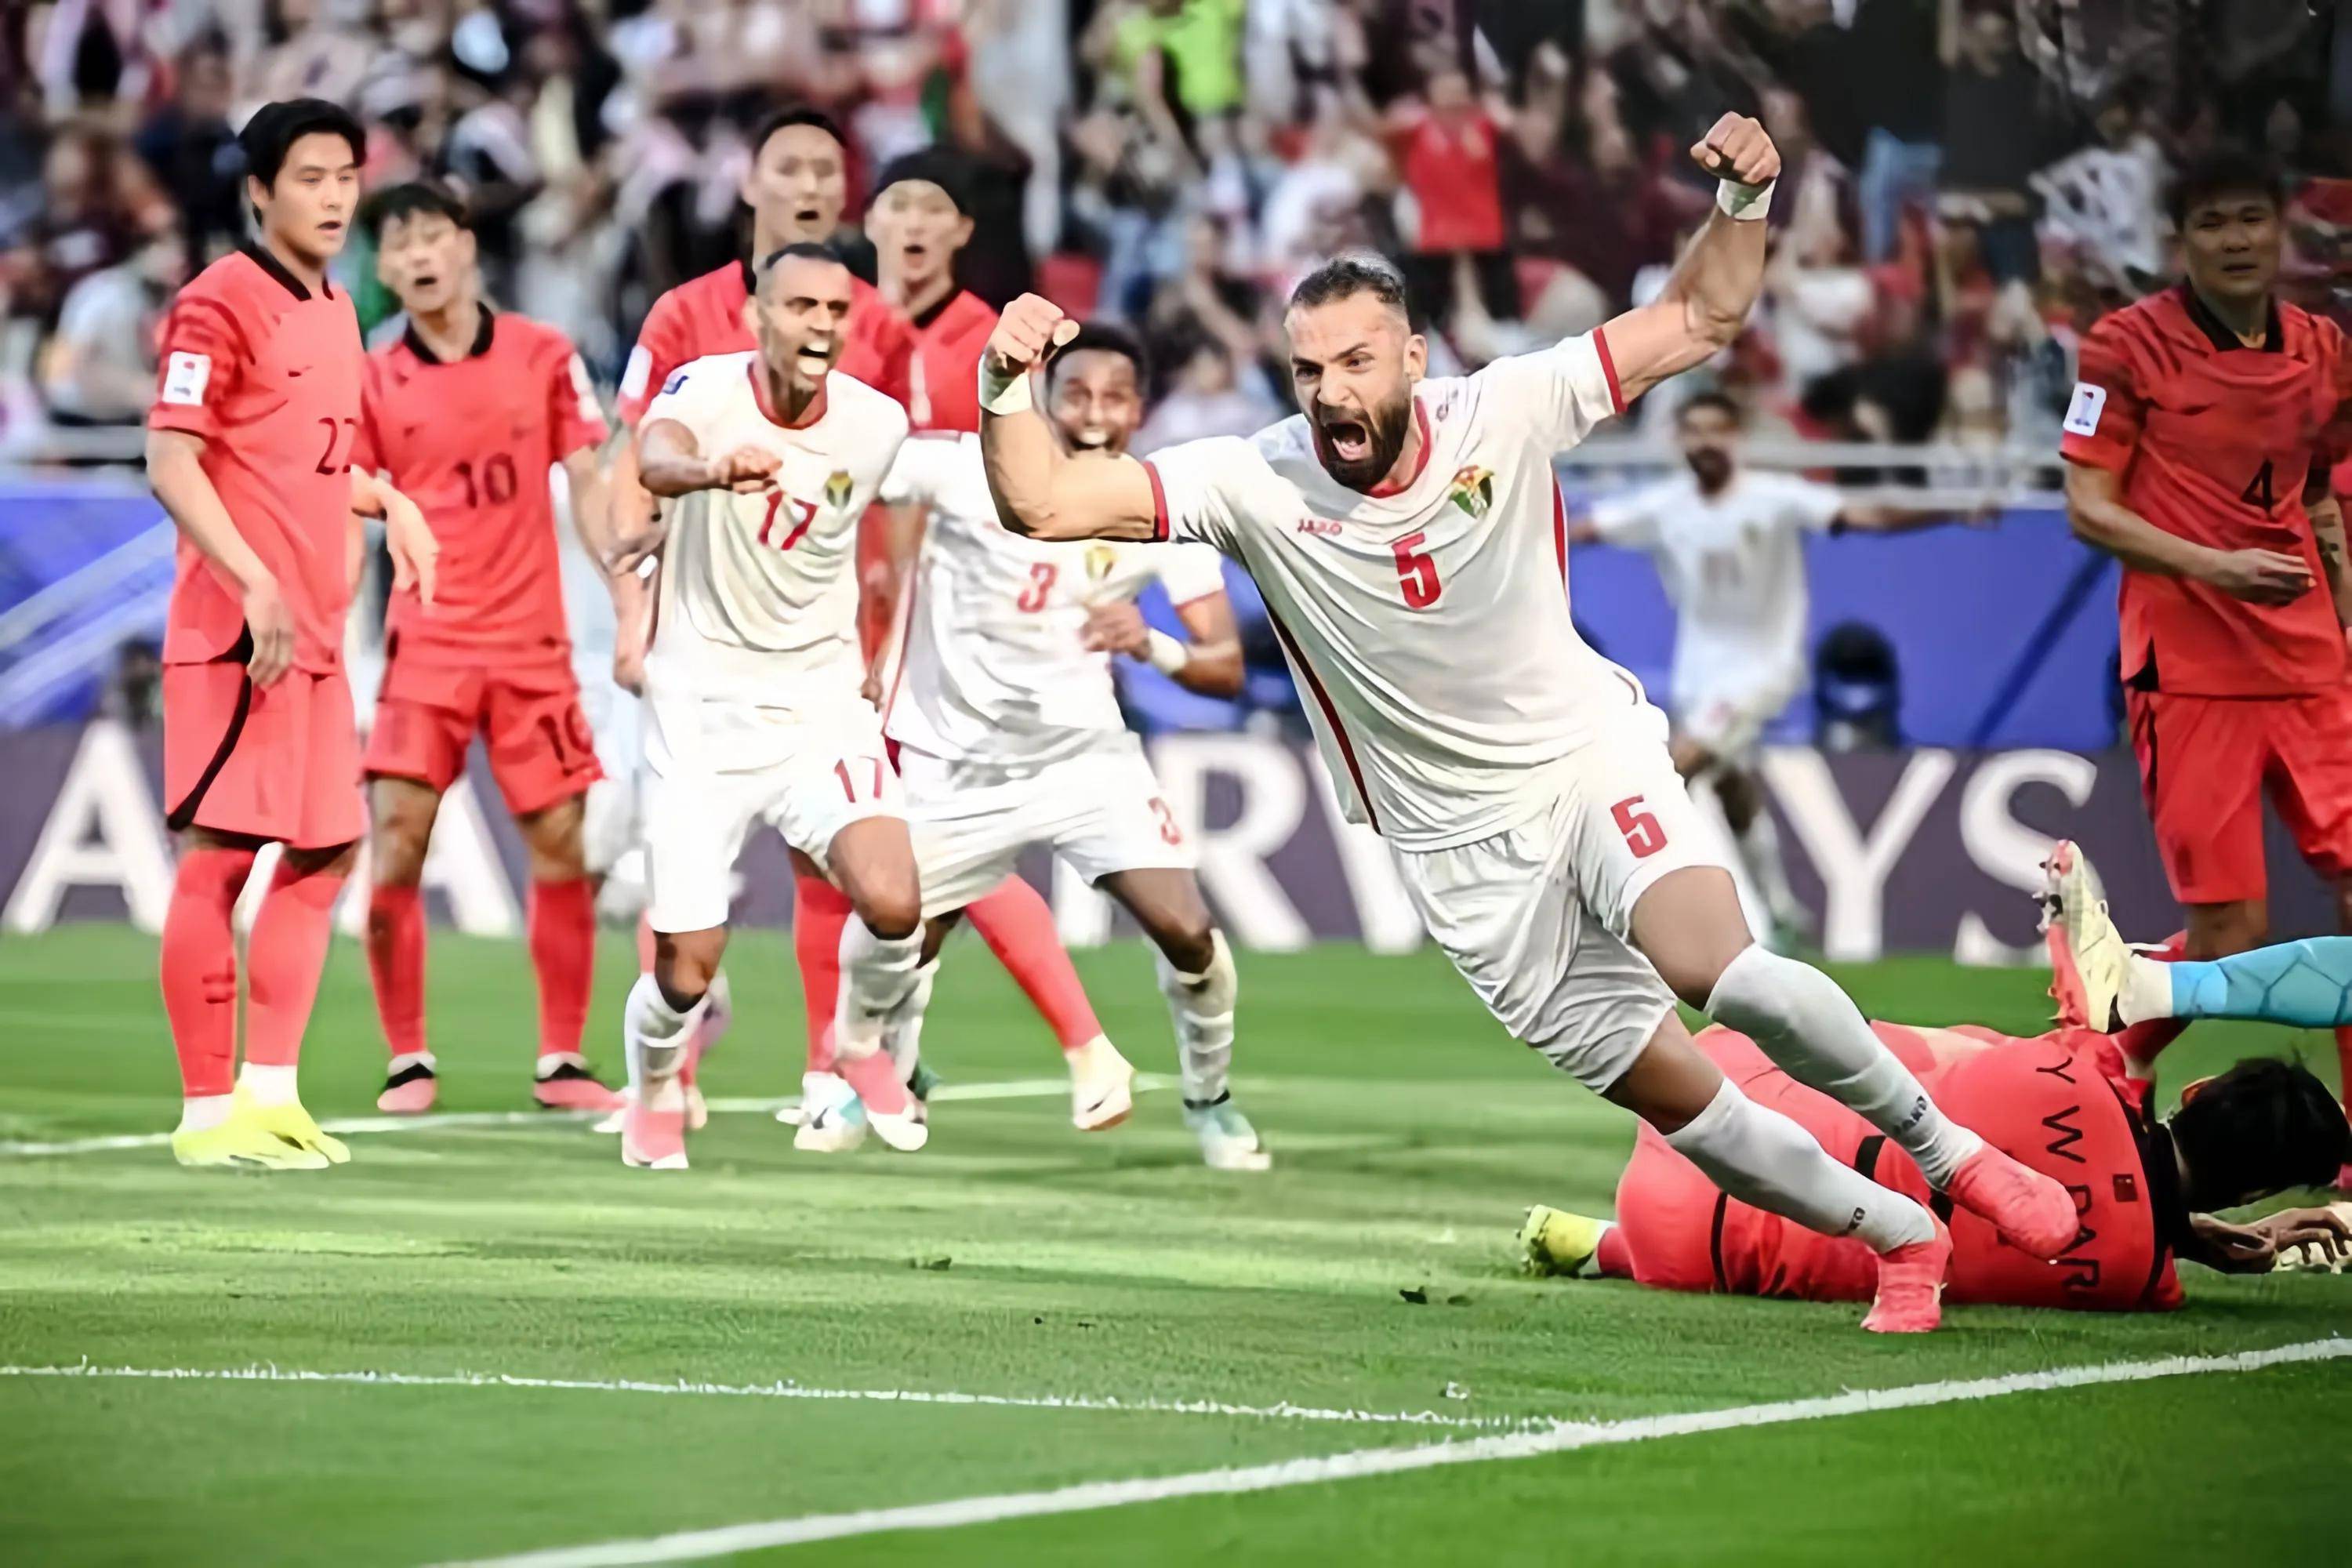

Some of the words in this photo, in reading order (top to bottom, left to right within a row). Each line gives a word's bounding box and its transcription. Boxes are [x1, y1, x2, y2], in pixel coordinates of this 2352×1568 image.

[448, 452, 518, 510] 10
[2240, 458, 2282, 515] 4
[757, 490, 818, 550] 17
[1016, 562, 1058, 613] 3
[1392, 532, 1442, 608] 5
[834, 756, 884, 803] 17
[1147, 797, 1182, 846] 3
[1610, 794, 1668, 858] 5
